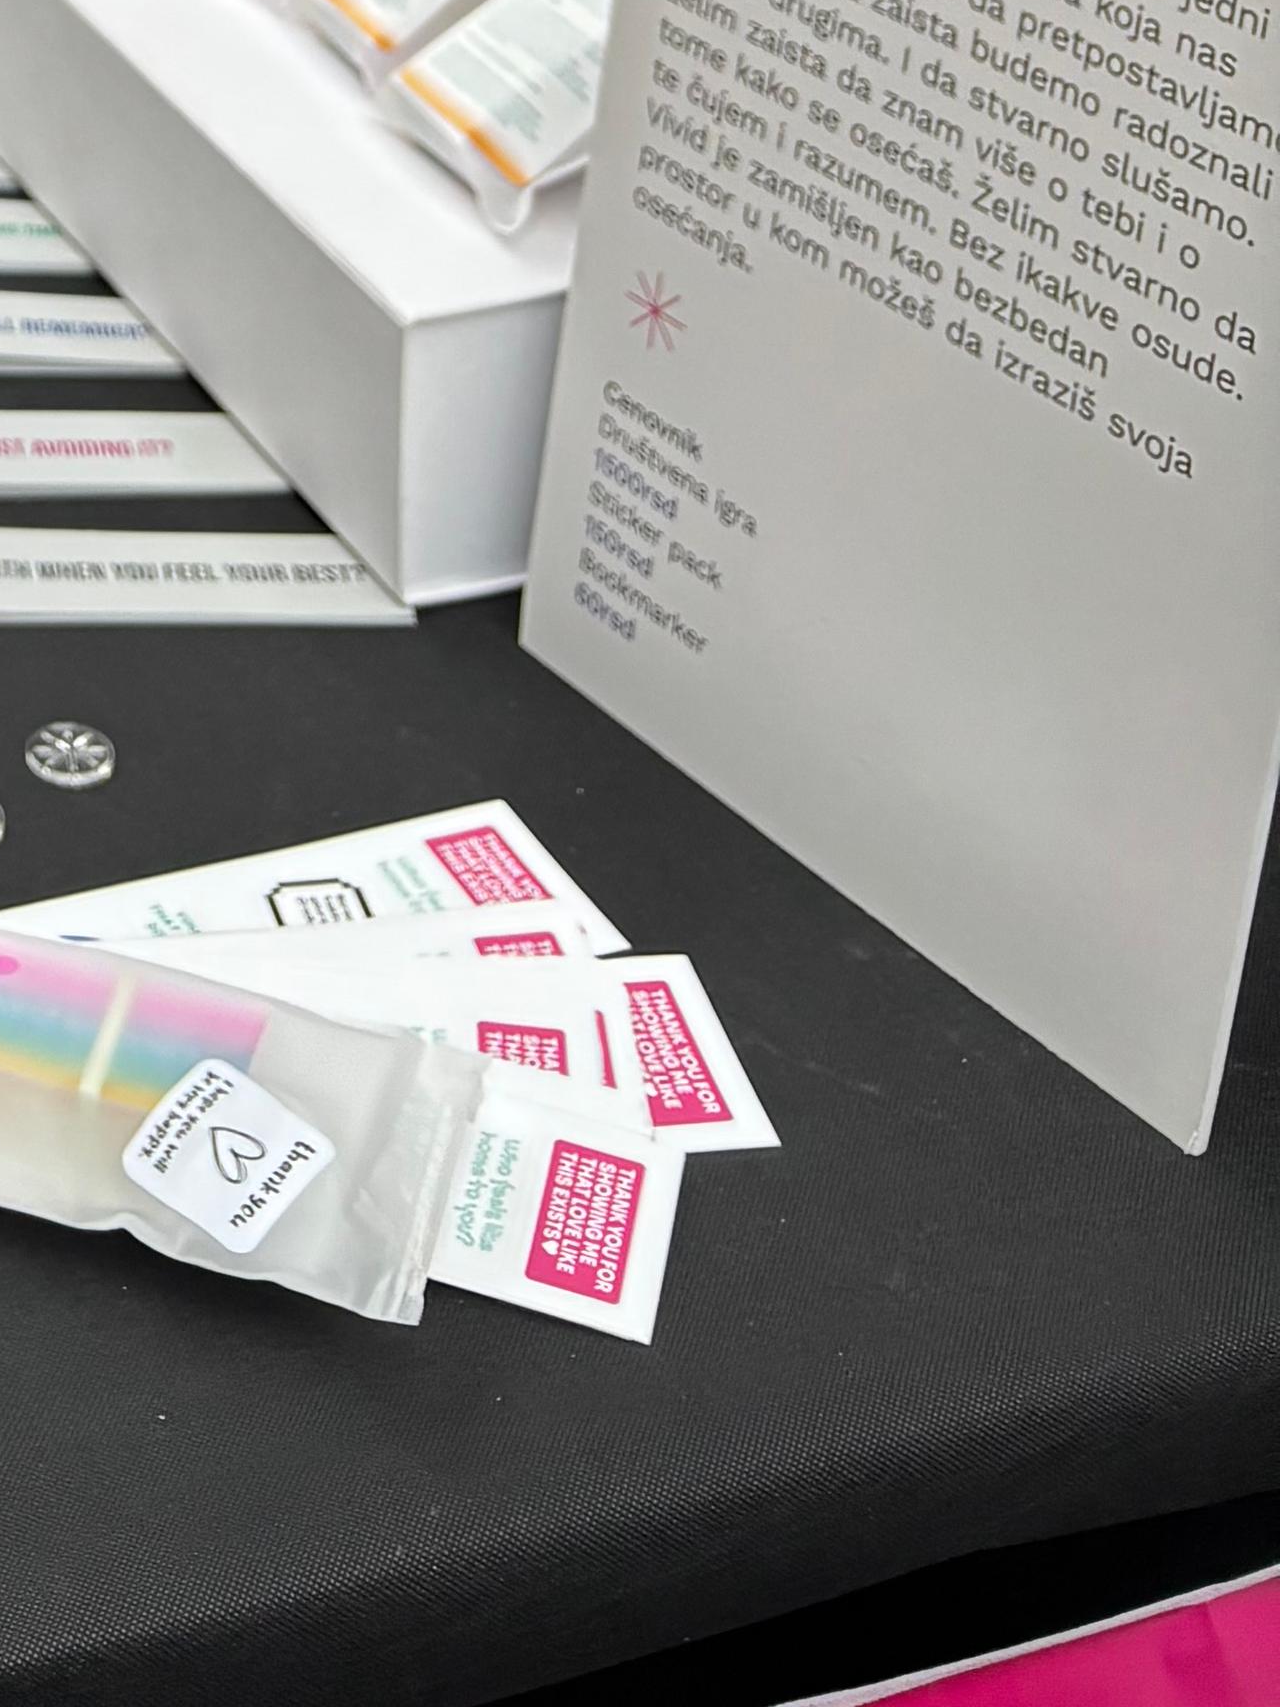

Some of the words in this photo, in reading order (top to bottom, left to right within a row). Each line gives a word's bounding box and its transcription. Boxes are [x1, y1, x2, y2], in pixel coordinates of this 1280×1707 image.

[1017, 11, 1280, 153] pretpostavljam
[1176, 32, 1237, 78] nas
[745, 19, 829, 82] zaista
[836, 64, 873, 105] da
[881, 89, 964, 151] znam
[976, 136, 1037, 186] više
[1048, 176, 1067, 202] o
[1082, 188, 1146, 243] tebi
[1157, 224, 1167, 254] i
[1180, 244, 1200, 269] o
[901, 46, 911, 74] I
[920, 59, 958, 99] da
[968, 85, 1089, 163] stvarno
[1101, 153, 1254, 247] slušamo.
[971, 29, 1100, 117] budemo
[1113, 107, 1273, 200] radoznali
[658, 17, 727, 73] tome
[735, 53, 799, 111] kako
[808, 99, 840, 133] se
[849, 122, 960, 200] osećaš.
[971, 175, 1059, 250] Želim
[1071, 239, 1199, 322] stvarno
[1215, 312, 1256, 355] da
[632, 185, 754, 274] osećanja.
[645, 95, 709, 155] Vivid
[710, 134, 742, 171] je
[747, 159, 880, 251] zamišljen
[890, 231, 944, 285] kao
[954, 267, 1108, 379] bezbedan
[653, 58, 680, 93] te
[686, 74, 768, 141] čujem
[776, 121, 788, 151] i
[794, 137, 937, 235] razumem.
[949, 219, 1005, 271] Bez
[1016, 251, 1119, 331] ikakve
[1131, 323, 1243, 401] osude.
[637, 144, 736, 212] prostor
[743, 202, 762, 231] u
[769, 210, 829, 271] kom
[840, 258, 936, 332] možeš
[945, 319, 983, 359] da
[994, 340, 1096, 421] izraziš
[1107, 412, 1193, 478] svoja
[35, 559, 107, 581] WHEN
[109, 561, 160, 582] YOU
[161, 561, 221, 582] FEEL
[222, 562, 290, 583] YOUR
[631, 991, 681, 1069] SHOWING
[668, 1070, 695, 1095] ME
[635, 1034, 666, 1073] LOVE
[651, 1075, 683, 1109] LIKE
[650, 989, 689, 1045] THANK
[677, 1046, 706, 1079] YOU
[692, 1082, 721, 1113] FOR
[260, 1141, 316, 1195] thank
[554, 1152, 578, 1187] THIS
[573, 1158, 599, 1196] THAT
[609, 1168, 636, 1226] THANK
[230, 1194, 267, 1227] you
[543, 1187, 572, 1239] EXISTS
[566, 1197, 589, 1240] LOVE
[584, 1161, 617, 1244] SHOWING
[556, 1240, 582, 1275] LIKE
[579, 1245, 600, 1268] ME
[594, 1259, 618, 1293] FOR
[601, 1227, 626, 1260] YOU
